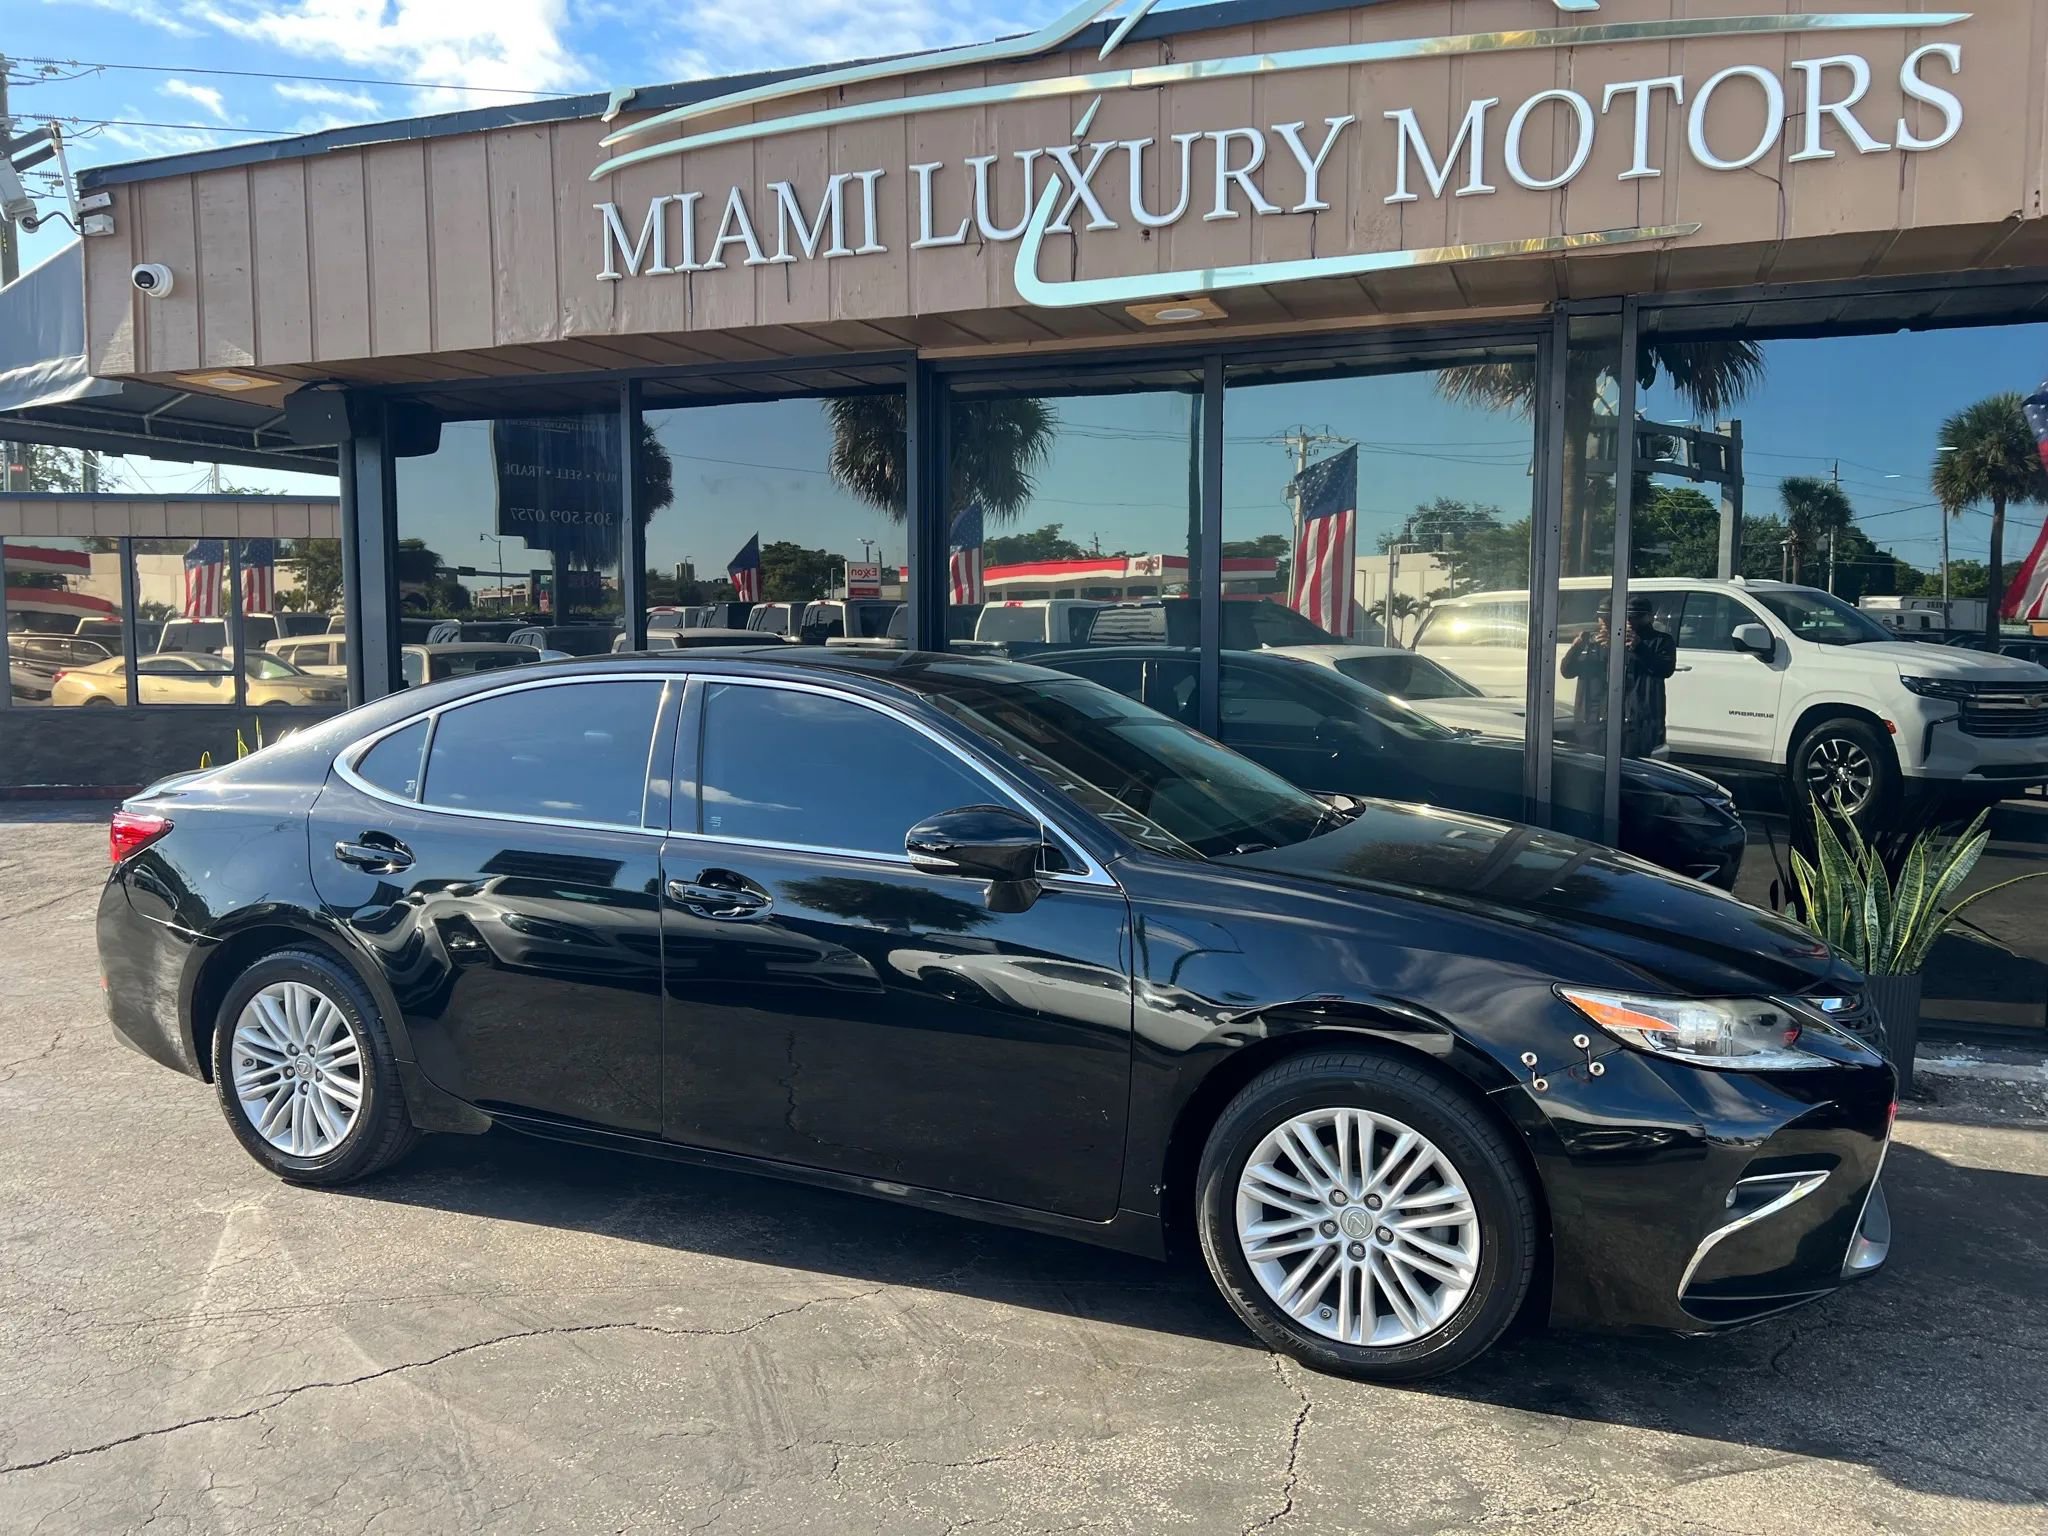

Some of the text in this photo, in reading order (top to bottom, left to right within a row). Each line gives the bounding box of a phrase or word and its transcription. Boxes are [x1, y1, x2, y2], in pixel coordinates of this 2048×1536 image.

[593, 43, 1963, 280] MIAMI LUXURY MOTORS
